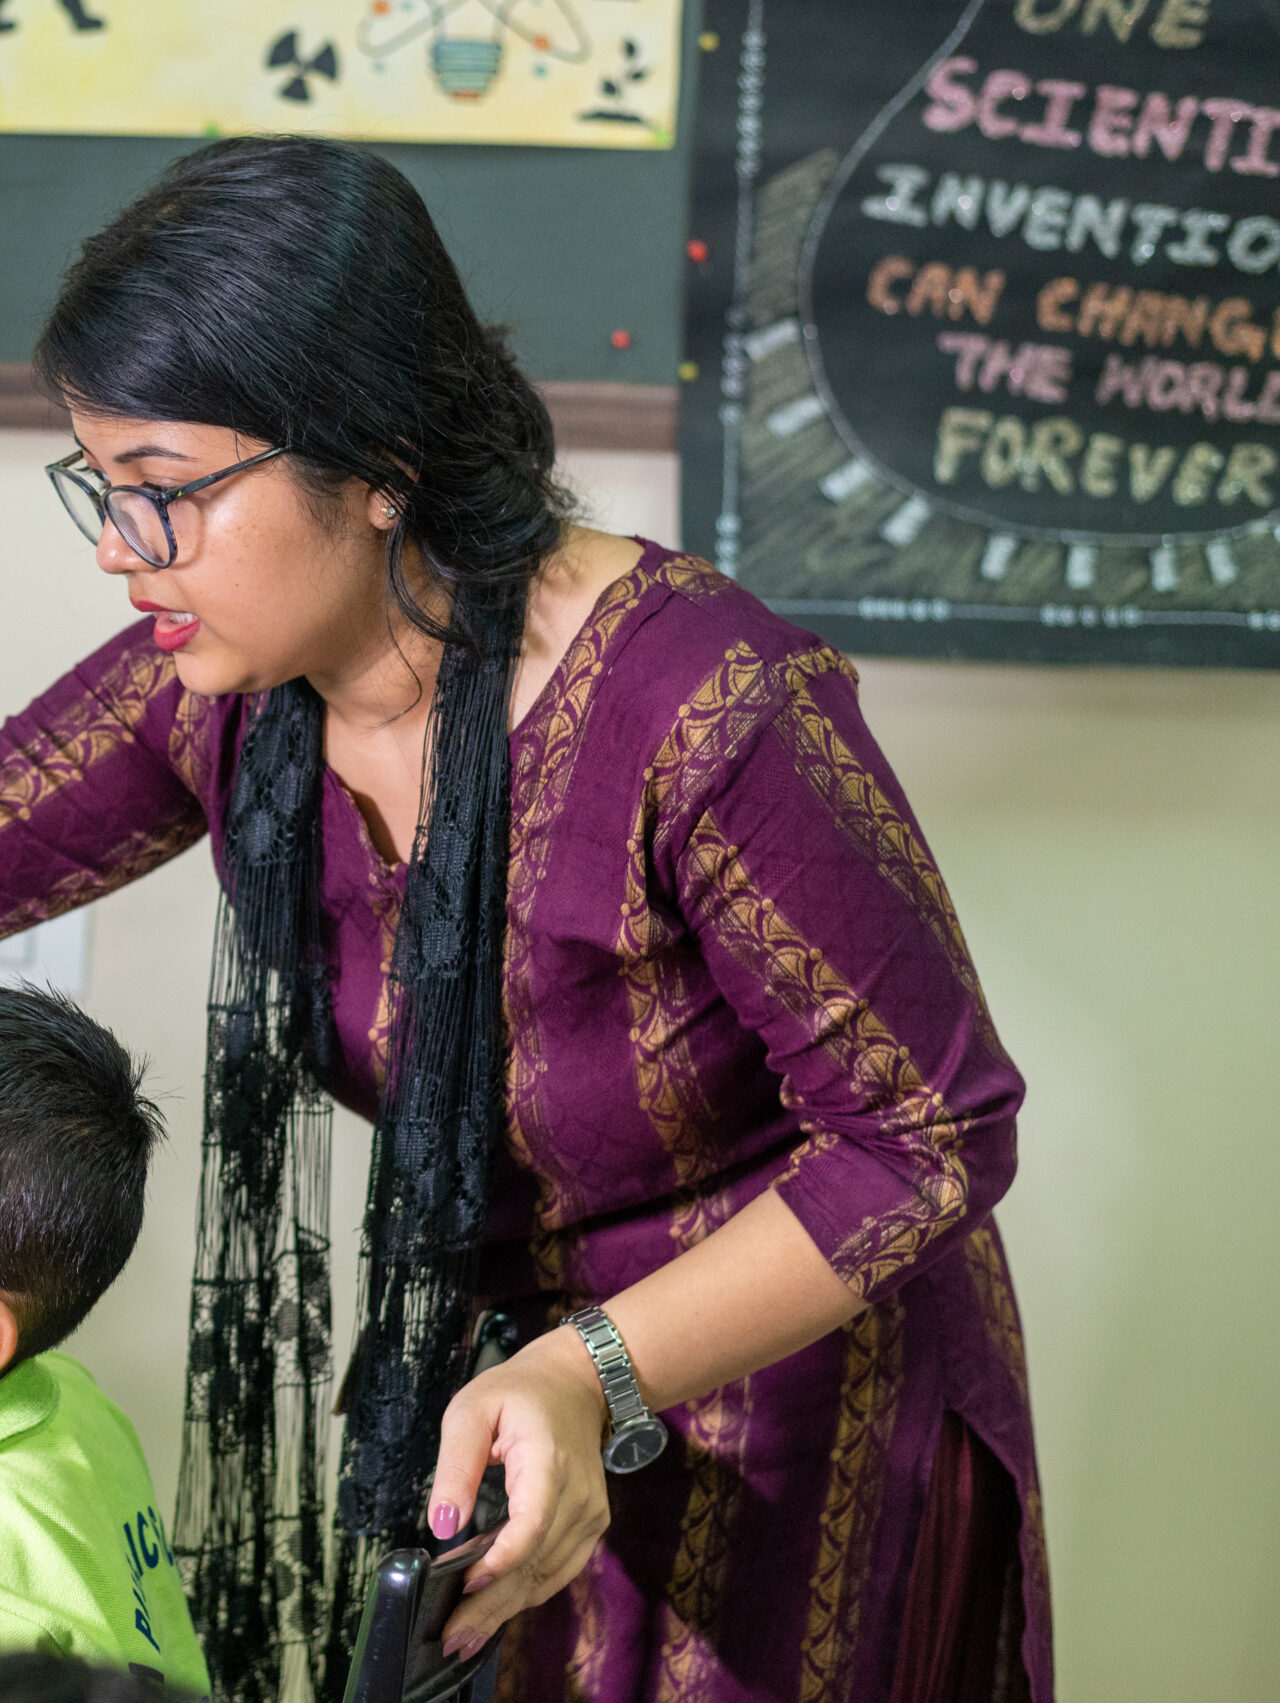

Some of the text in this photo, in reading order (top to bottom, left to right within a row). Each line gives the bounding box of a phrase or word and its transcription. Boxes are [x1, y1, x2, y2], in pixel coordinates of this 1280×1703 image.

[1013, 0, 1210, 49] ONE
[867, 255, 1280, 363] CAN CHANG
[938, 331, 1072, 403] THE
[933, 407, 1280, 508] FOREVER
